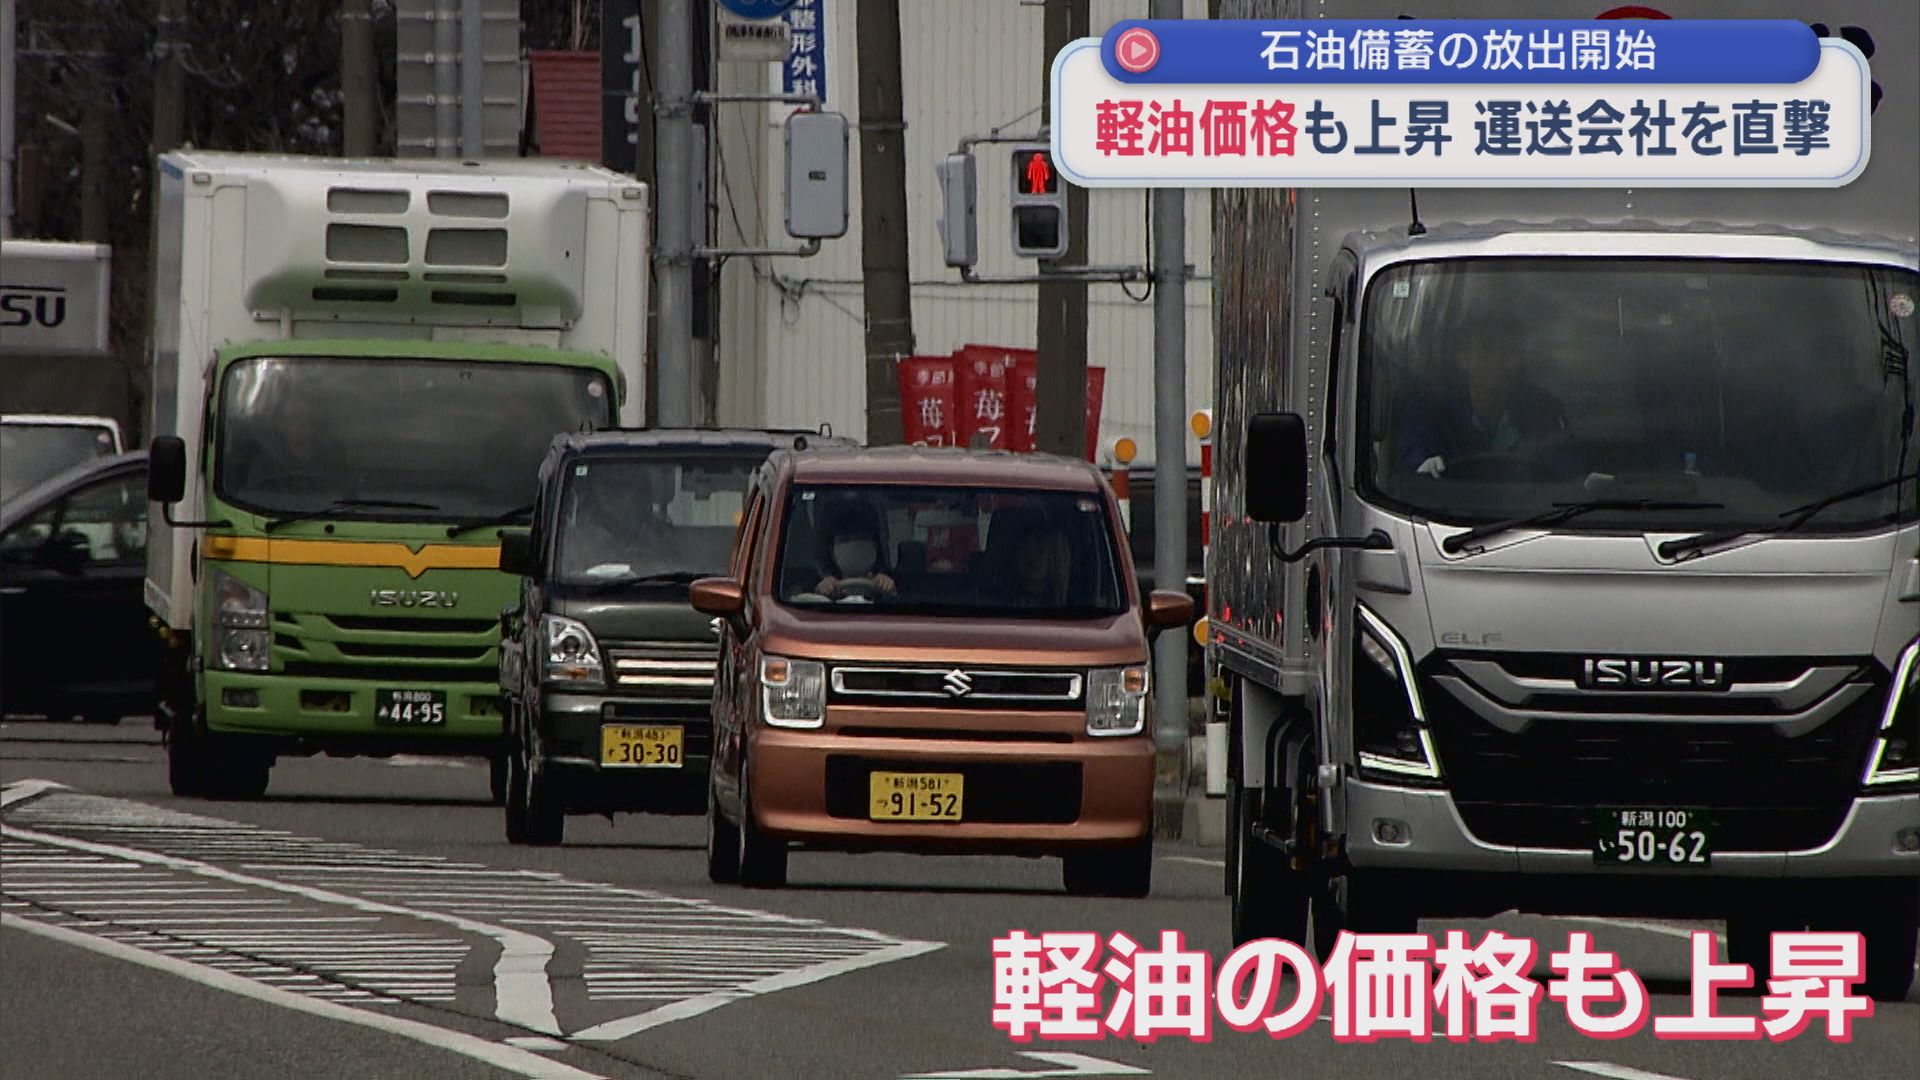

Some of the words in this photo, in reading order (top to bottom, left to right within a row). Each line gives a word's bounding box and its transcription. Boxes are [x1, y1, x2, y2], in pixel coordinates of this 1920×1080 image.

[790, 0, 818, 96] 整形外科
[369, 589, 459, 608] ISUZU
[1440, 632, 1502, 646] ELF
[1584, 658, 1724, 685] ISUZU
